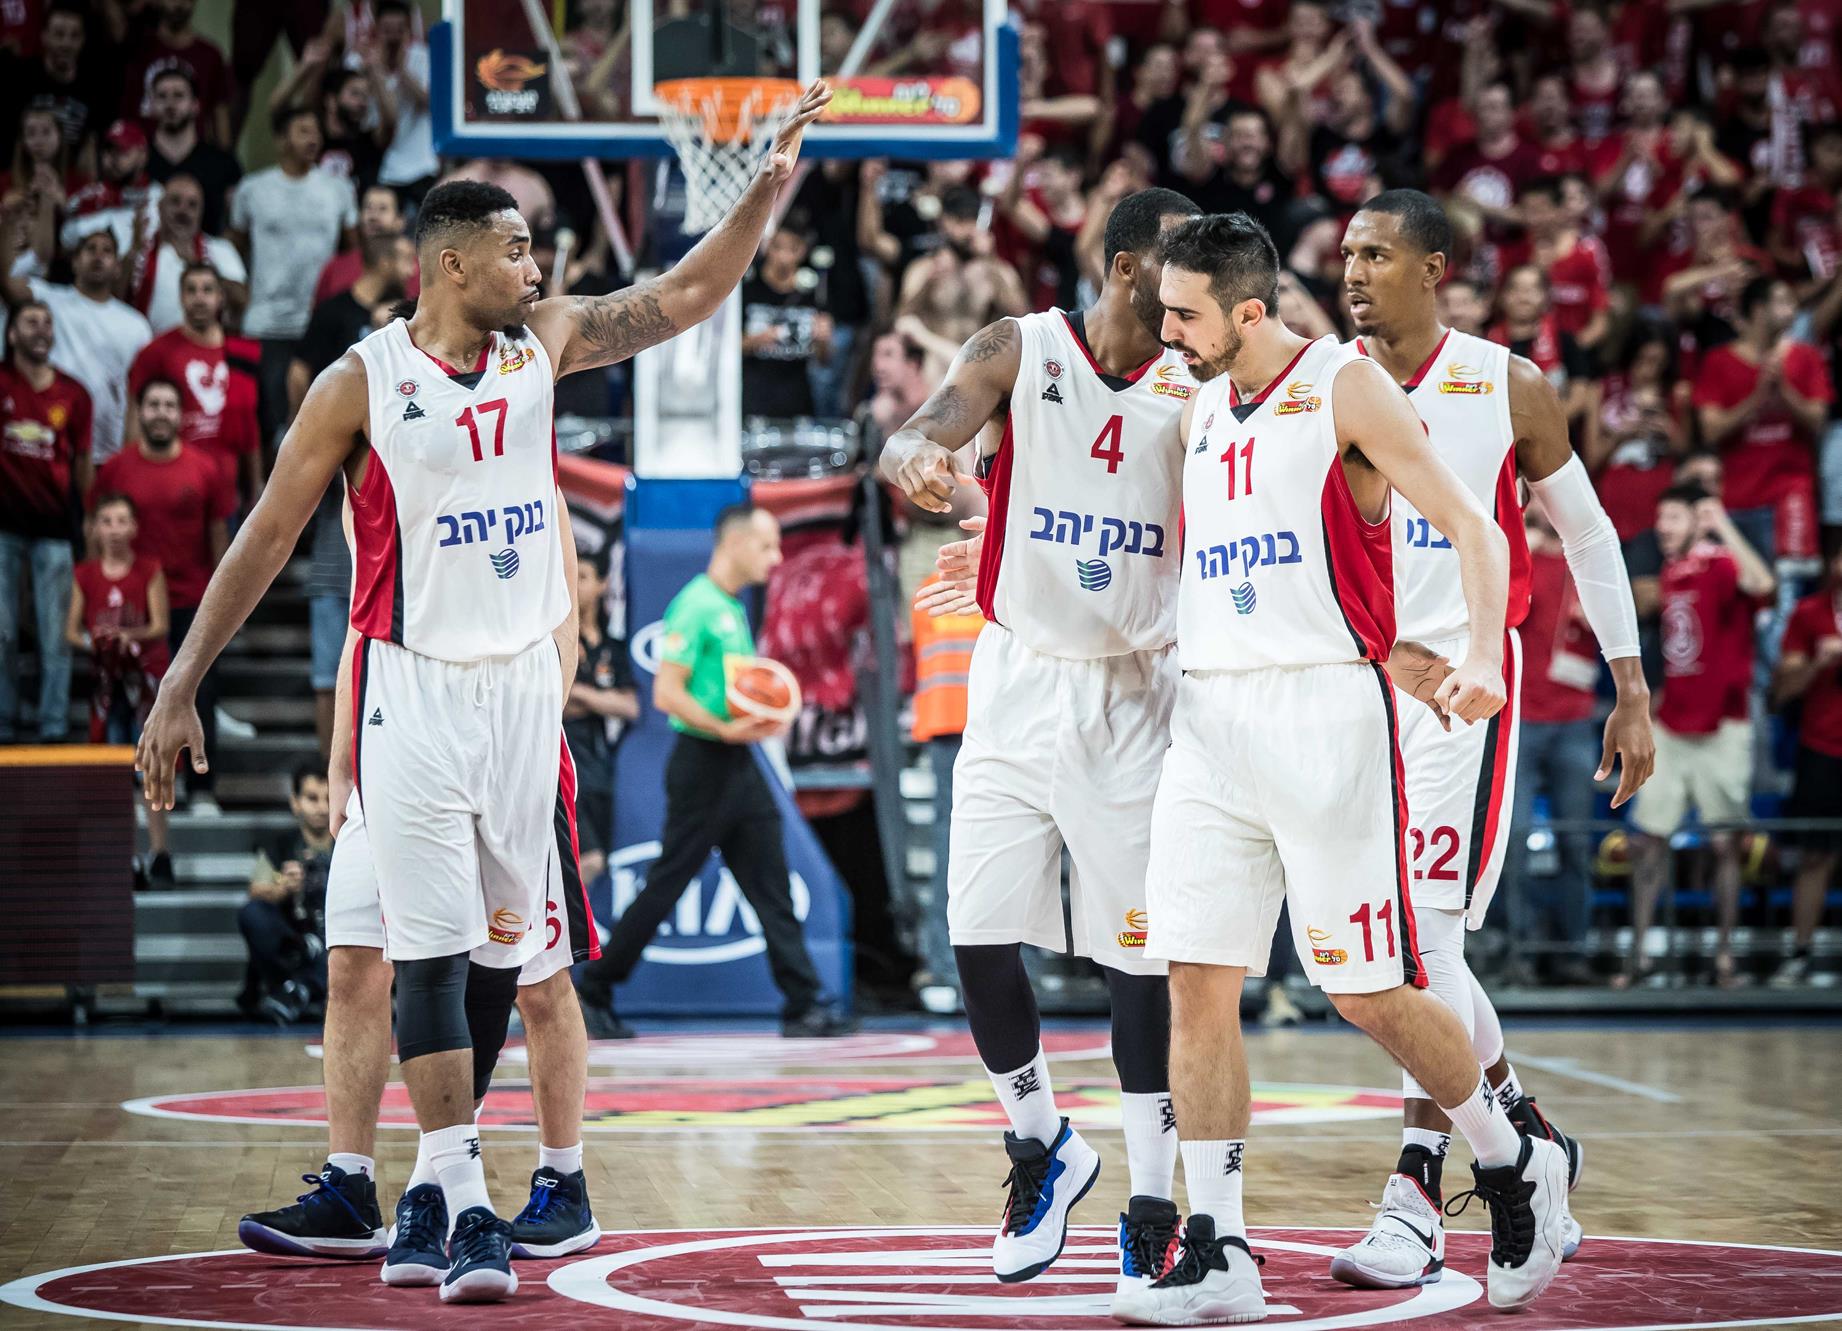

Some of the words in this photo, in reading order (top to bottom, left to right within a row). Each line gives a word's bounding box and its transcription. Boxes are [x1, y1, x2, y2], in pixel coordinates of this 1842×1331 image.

[455, 398, 508, 462] 17
[1091, 415, 1124, 474] 4
[1220, 437, 1255, 501] 11
[437, 509, 496, 547] יהב
[503, 500, 545, 545] בנק
[1030, 506, 1094, 545] יהב
[1099, 517, 1164, 557] בנק
[1241, 531, 1302, 577] בנק
[1409, 826, 1460, 880] 22
[1350, 899, 1395, 962] 11
[1009, 1066, 1040, 1100] PEAK
[1225, 1142, 1245, 1174] PEAK
